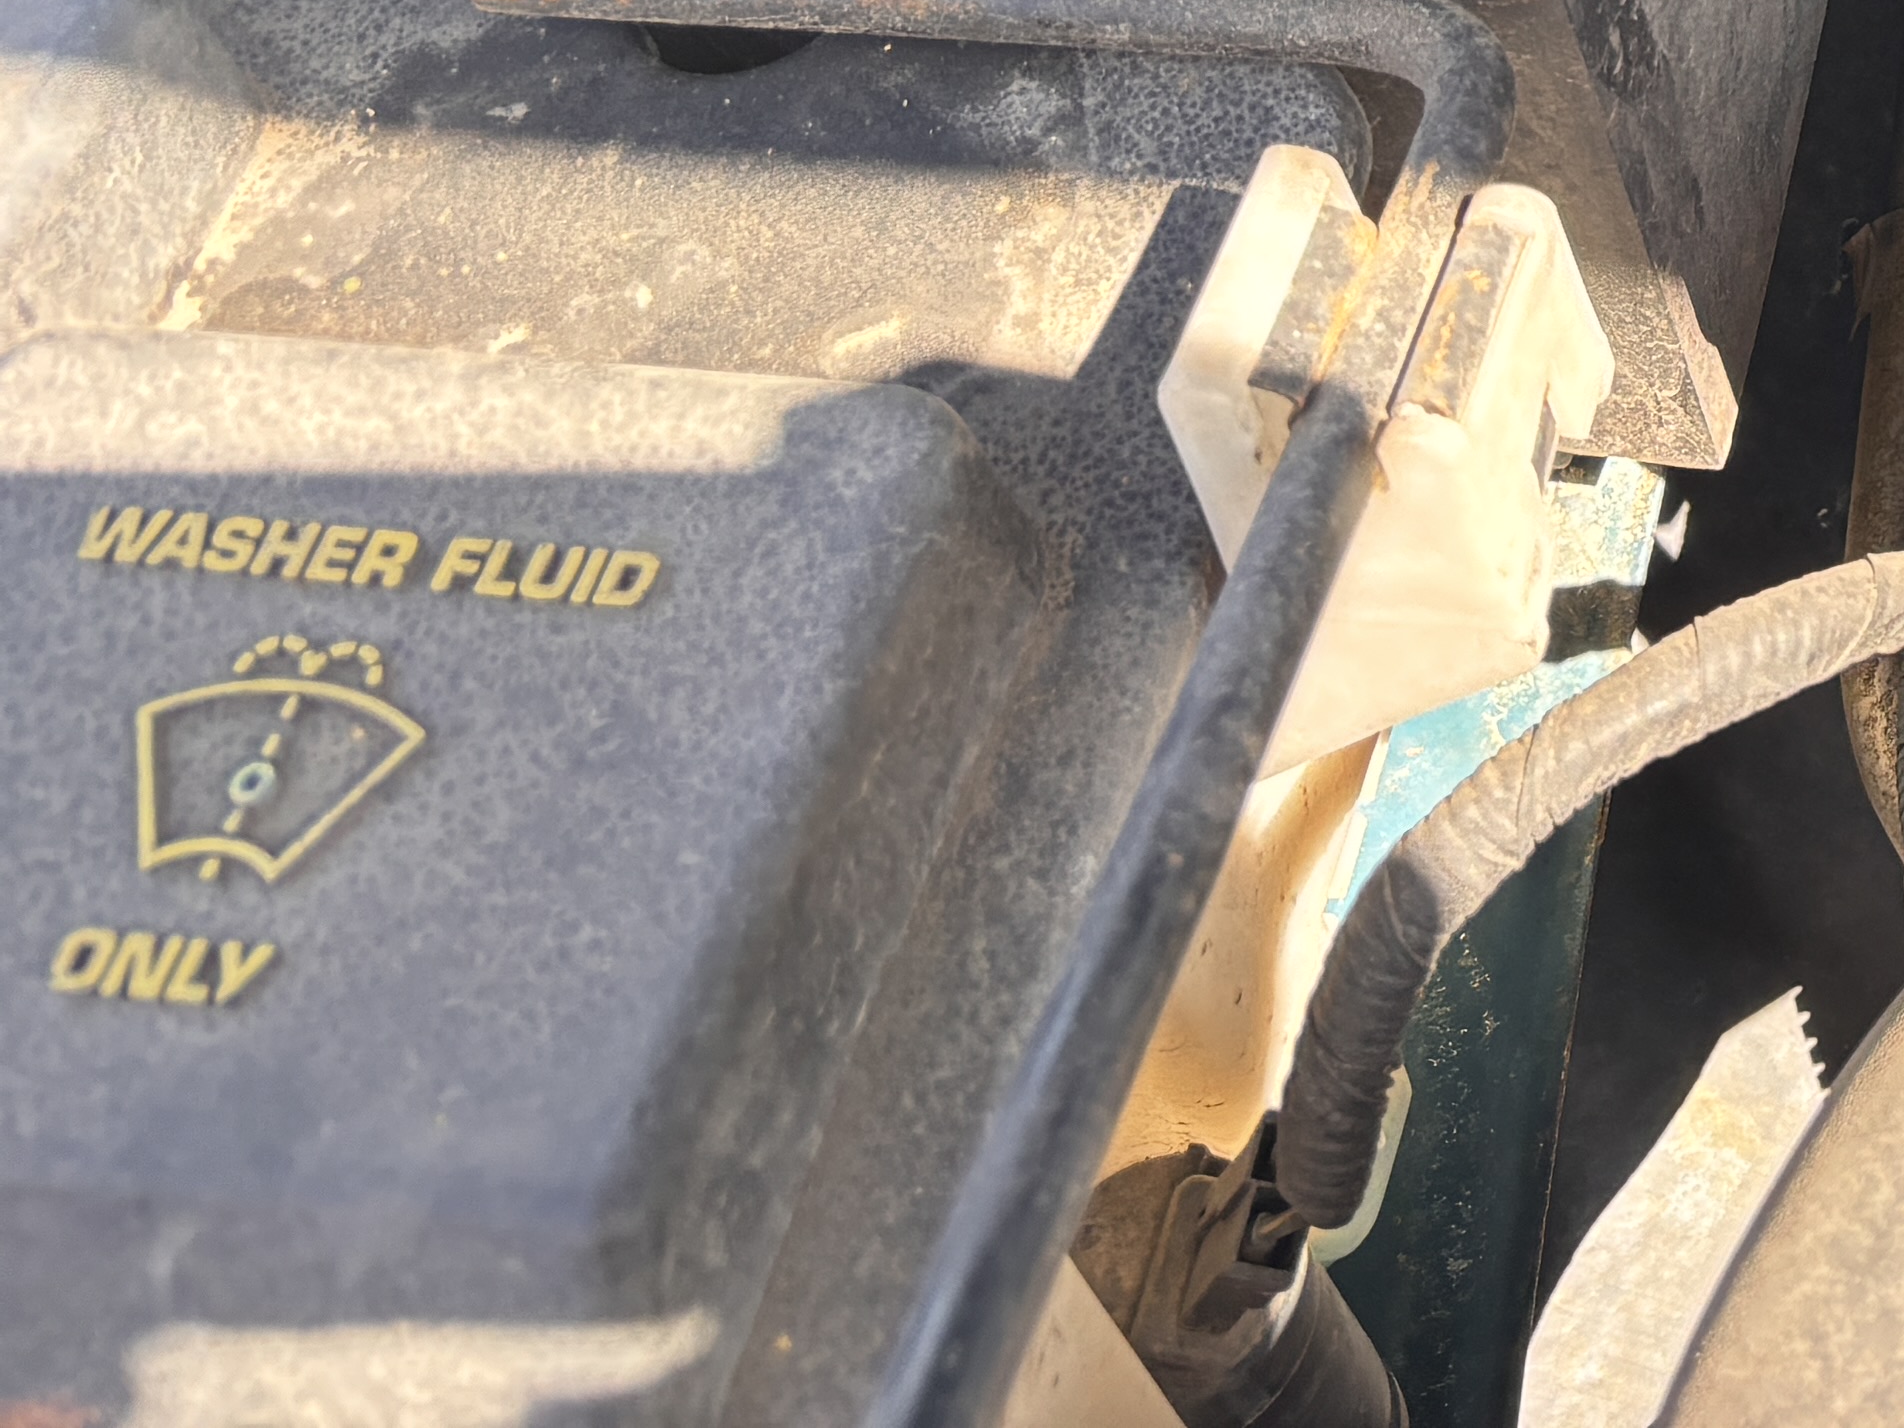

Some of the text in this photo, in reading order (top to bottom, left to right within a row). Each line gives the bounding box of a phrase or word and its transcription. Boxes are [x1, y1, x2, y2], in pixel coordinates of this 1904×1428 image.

[77, 505, 662, 607] WASHER FLUID
[48, 926, 276, 1005] ONLY
